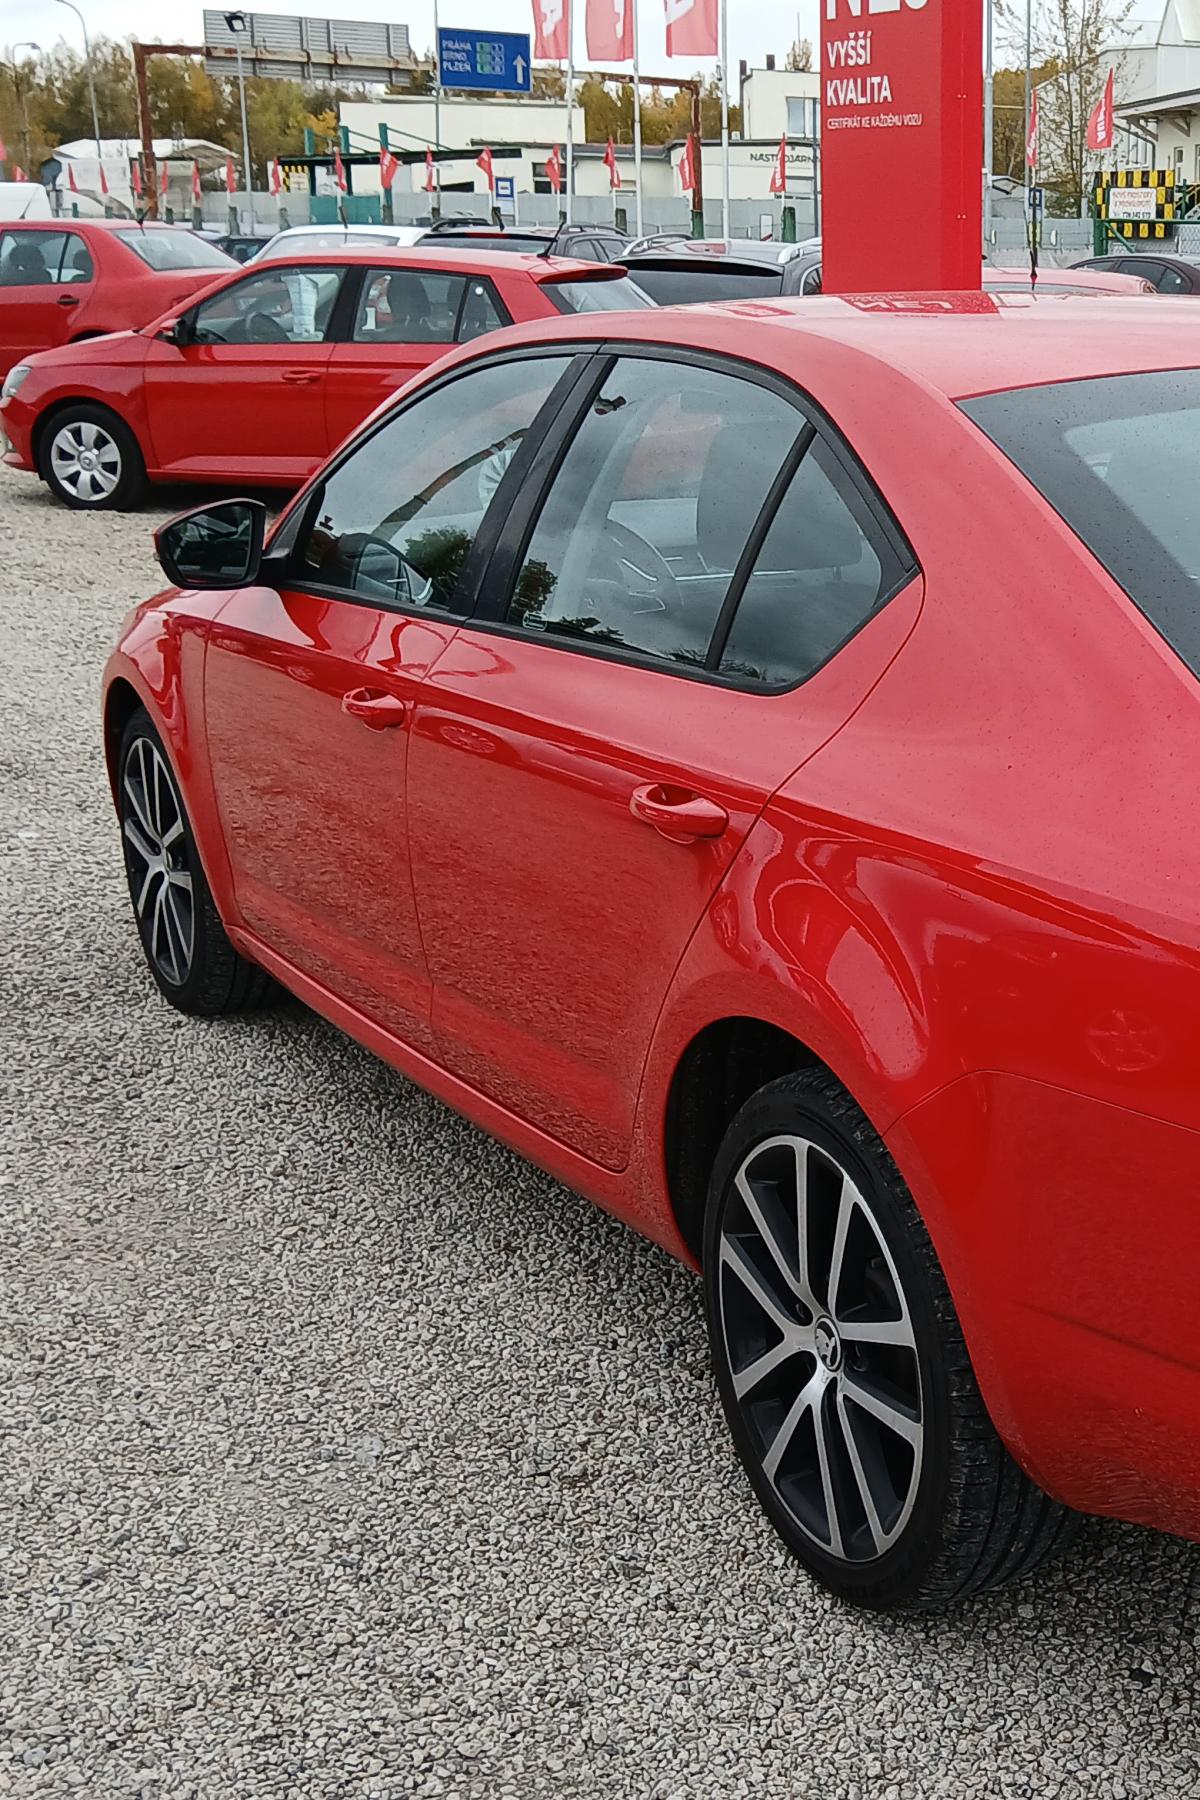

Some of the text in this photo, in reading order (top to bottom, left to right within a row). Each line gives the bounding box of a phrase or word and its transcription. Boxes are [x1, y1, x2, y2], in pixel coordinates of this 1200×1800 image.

[826, 30, 872, 68] VYŠŠÍ
[826, 75, 892, 106] KVALITA
[861, 116, 870, 128] KE
[903, 113, 923, 126] VOZU
